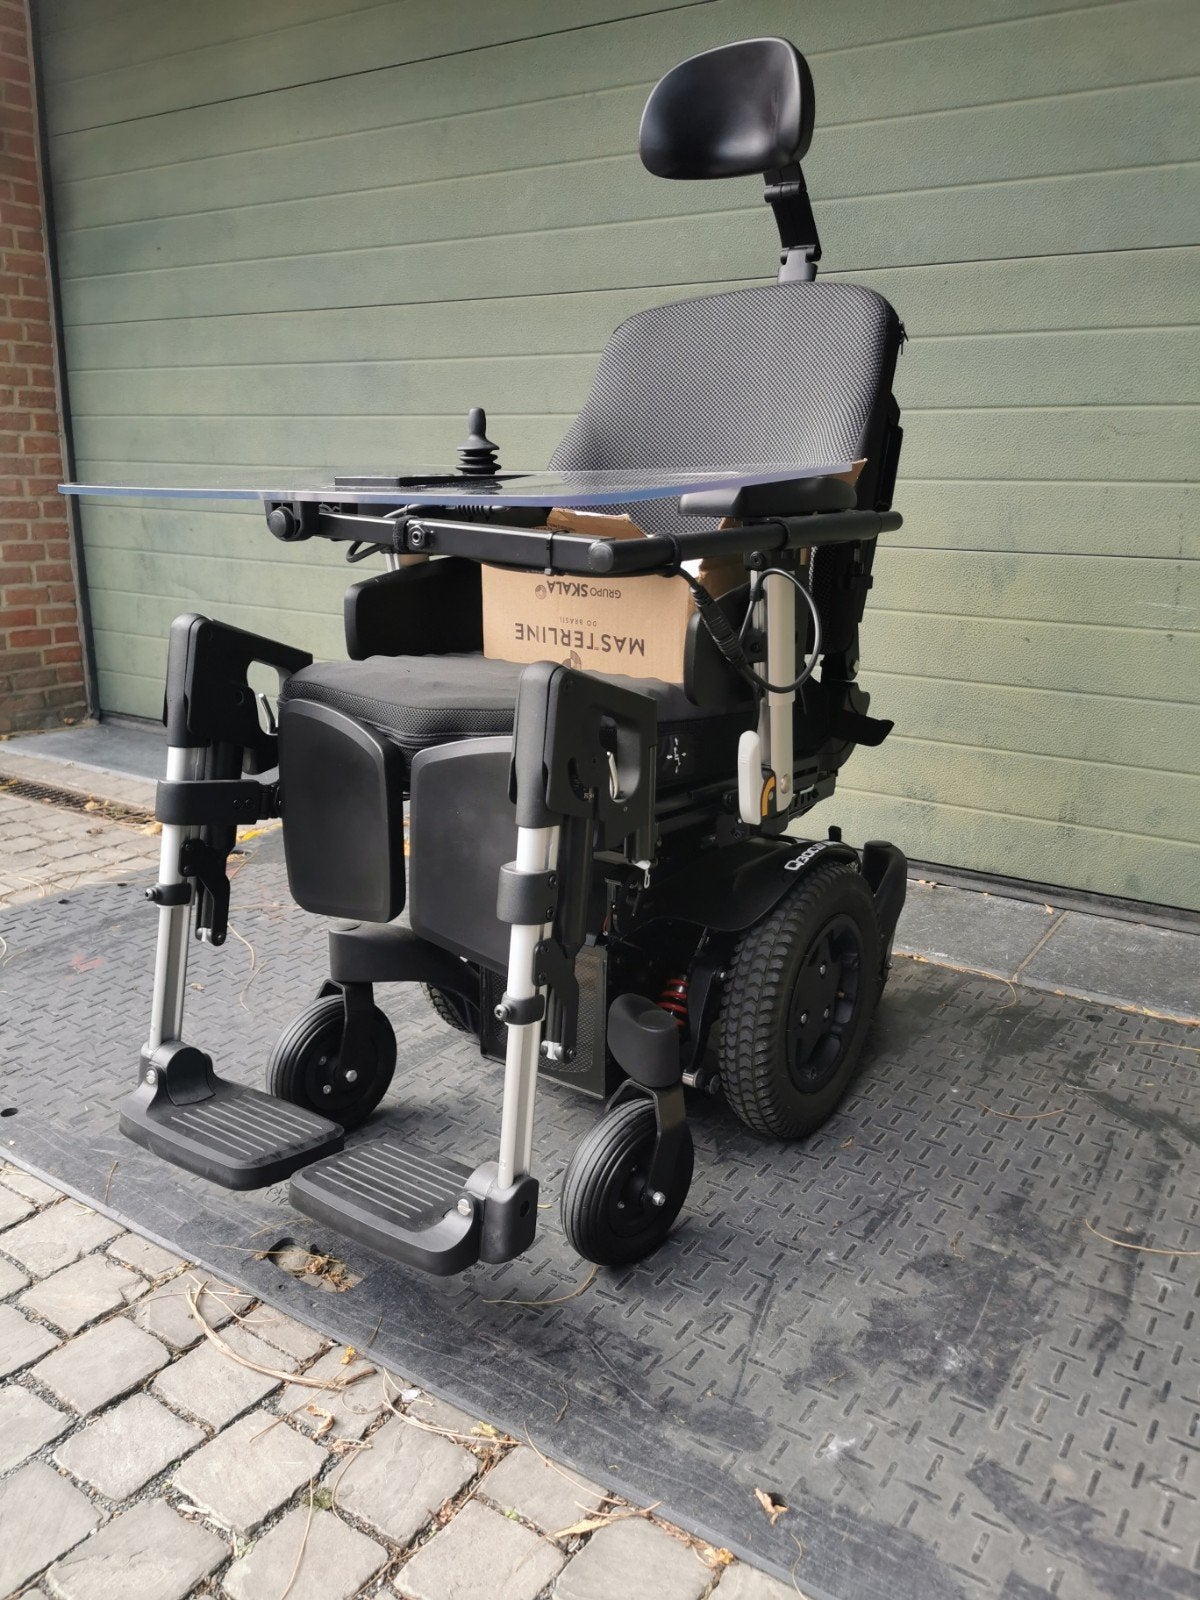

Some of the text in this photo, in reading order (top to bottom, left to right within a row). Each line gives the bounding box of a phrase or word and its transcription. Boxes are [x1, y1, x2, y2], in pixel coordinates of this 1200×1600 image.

[547, 581, 621, 599] GRUPO SKALA
[586, 619, 597, 627] DO
[515, 622, 645, 656] MASTERLINE
